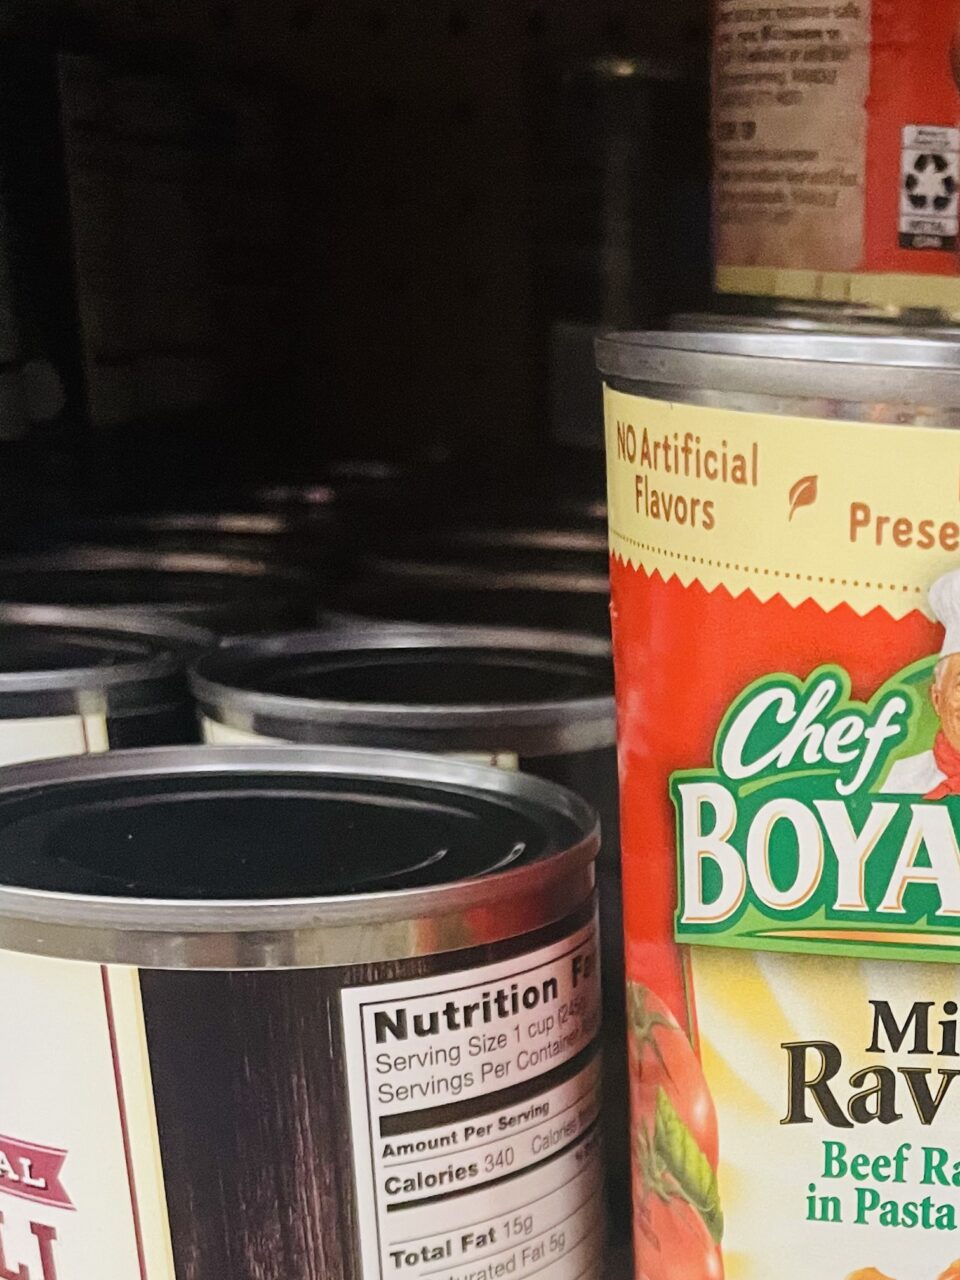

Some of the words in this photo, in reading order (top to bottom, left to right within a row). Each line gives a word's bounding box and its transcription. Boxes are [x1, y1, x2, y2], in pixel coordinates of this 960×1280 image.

[617, 421, 636, 464] NO
[641, 427, 758, 486] Artificial
[635, 475, 715, 530] Flavors
[722, 679, 908, 796] Chef
[374, 975, 559, 1043] Nutrition
[376, 1042, 461, 1075] Serving
[468, 1031, 508, 1059] Size
[513, 1024, 522, 1045] 1
[528, 1015, 555, 1039] cup
[378, 1067, 475, 1104] Servings
[480, 1058, 511, 1084] Per
[382, 1131, 458, 1160] Amount
[464, 1120, 494, 1143] Per
[497, 1101, 551, 1132] Serving
[384, 1161, 479, 1196] Calories
[484, 1147, 516, 1175] 340
[821, 1140, 912, 1185] Beef
[805, 1183, 844, 1223] in
[853, 1188, 959, 1232] Pasta
[389, 1239, 452, 1270] Total
[460, 1227, 497, 1257] Fat
[503, 1213, 534, 1241] 15g
[521, 1243, 546, 1267] Fat
